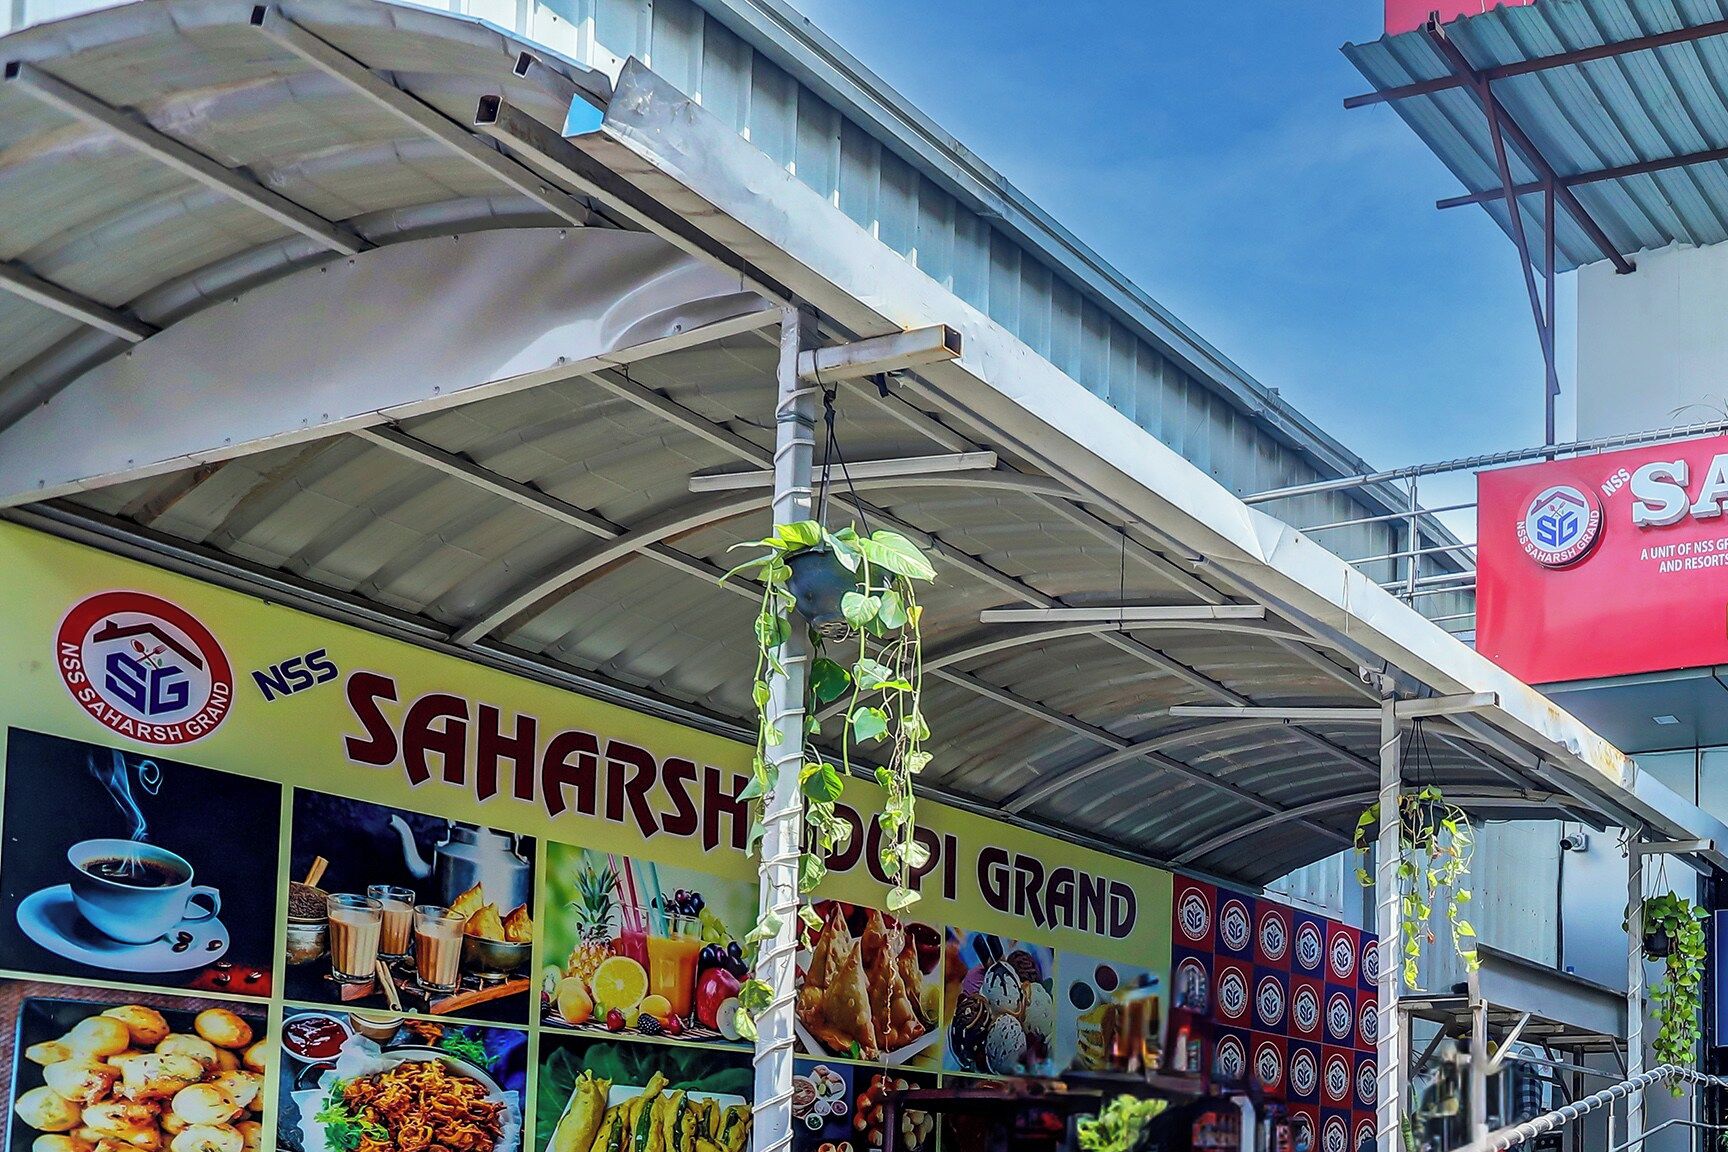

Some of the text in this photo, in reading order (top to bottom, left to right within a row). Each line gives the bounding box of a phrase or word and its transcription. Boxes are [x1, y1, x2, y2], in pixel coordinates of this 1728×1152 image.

[1600, 467, 1631, 498] NSS
[1516, 510, 1600, 563] NSS SAHARSH GRAND
[1640, 549, 1649, 561] A
[1650, 545, 1676, 559] UNIT
[1678, 544, 1693, 556] OF
[1694, 541, 1715, 554] NSS
[1659, 558, 1684, 573] AND
[61, 642, 230, 742] NSS SAHARSH GRAND
[251, 649, 1138, 940] NSS SAHARSH DUPI GRAND
